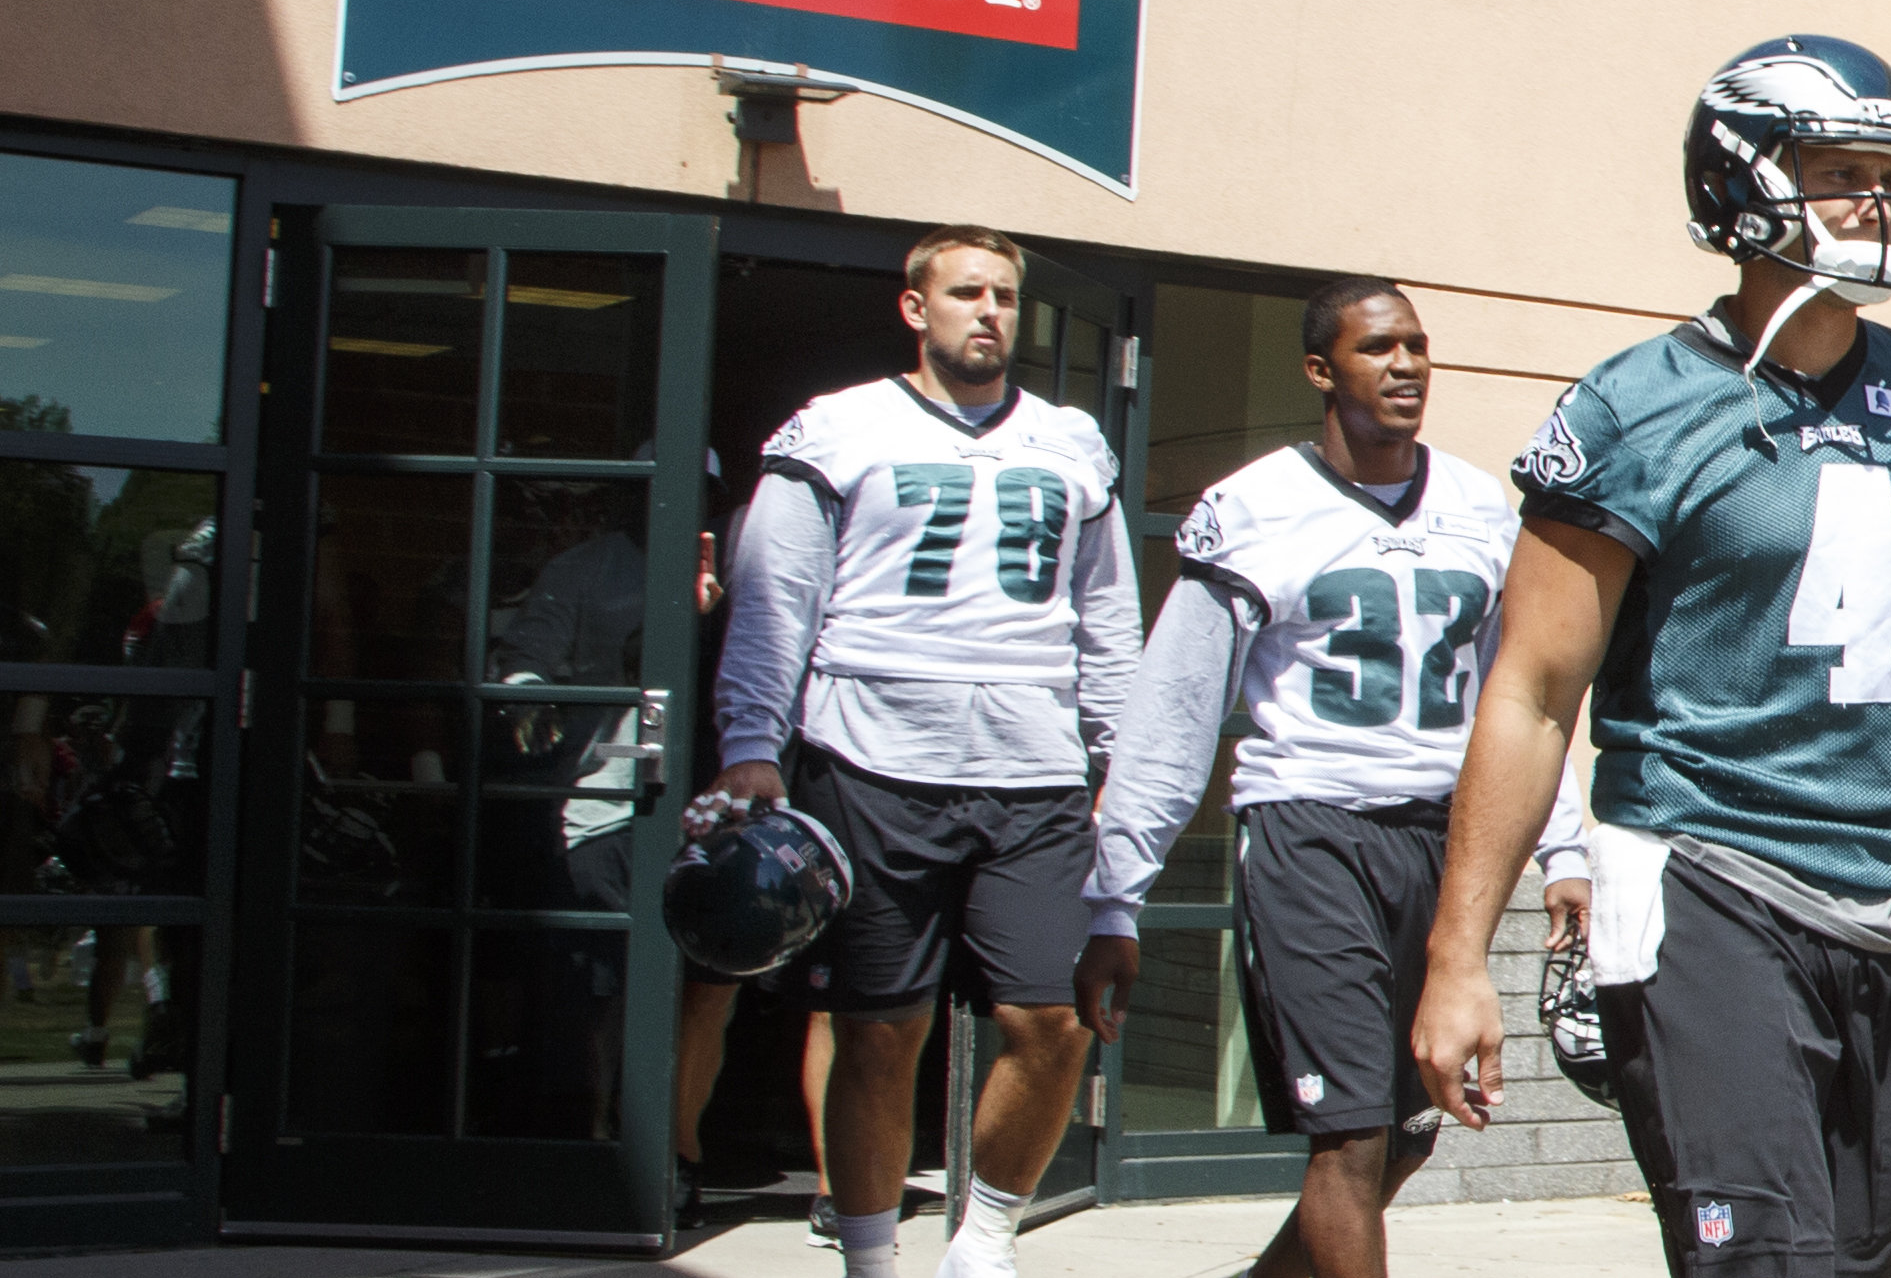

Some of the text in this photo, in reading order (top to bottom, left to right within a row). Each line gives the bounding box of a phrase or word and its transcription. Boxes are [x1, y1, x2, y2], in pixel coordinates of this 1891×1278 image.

[1800, 424, 1867, 453] EAGLES
[891, 463, 1069, 605] 78
[1305, 568, 1491, 730] 32
[1703, 1219, 1730, 1239] NFL
